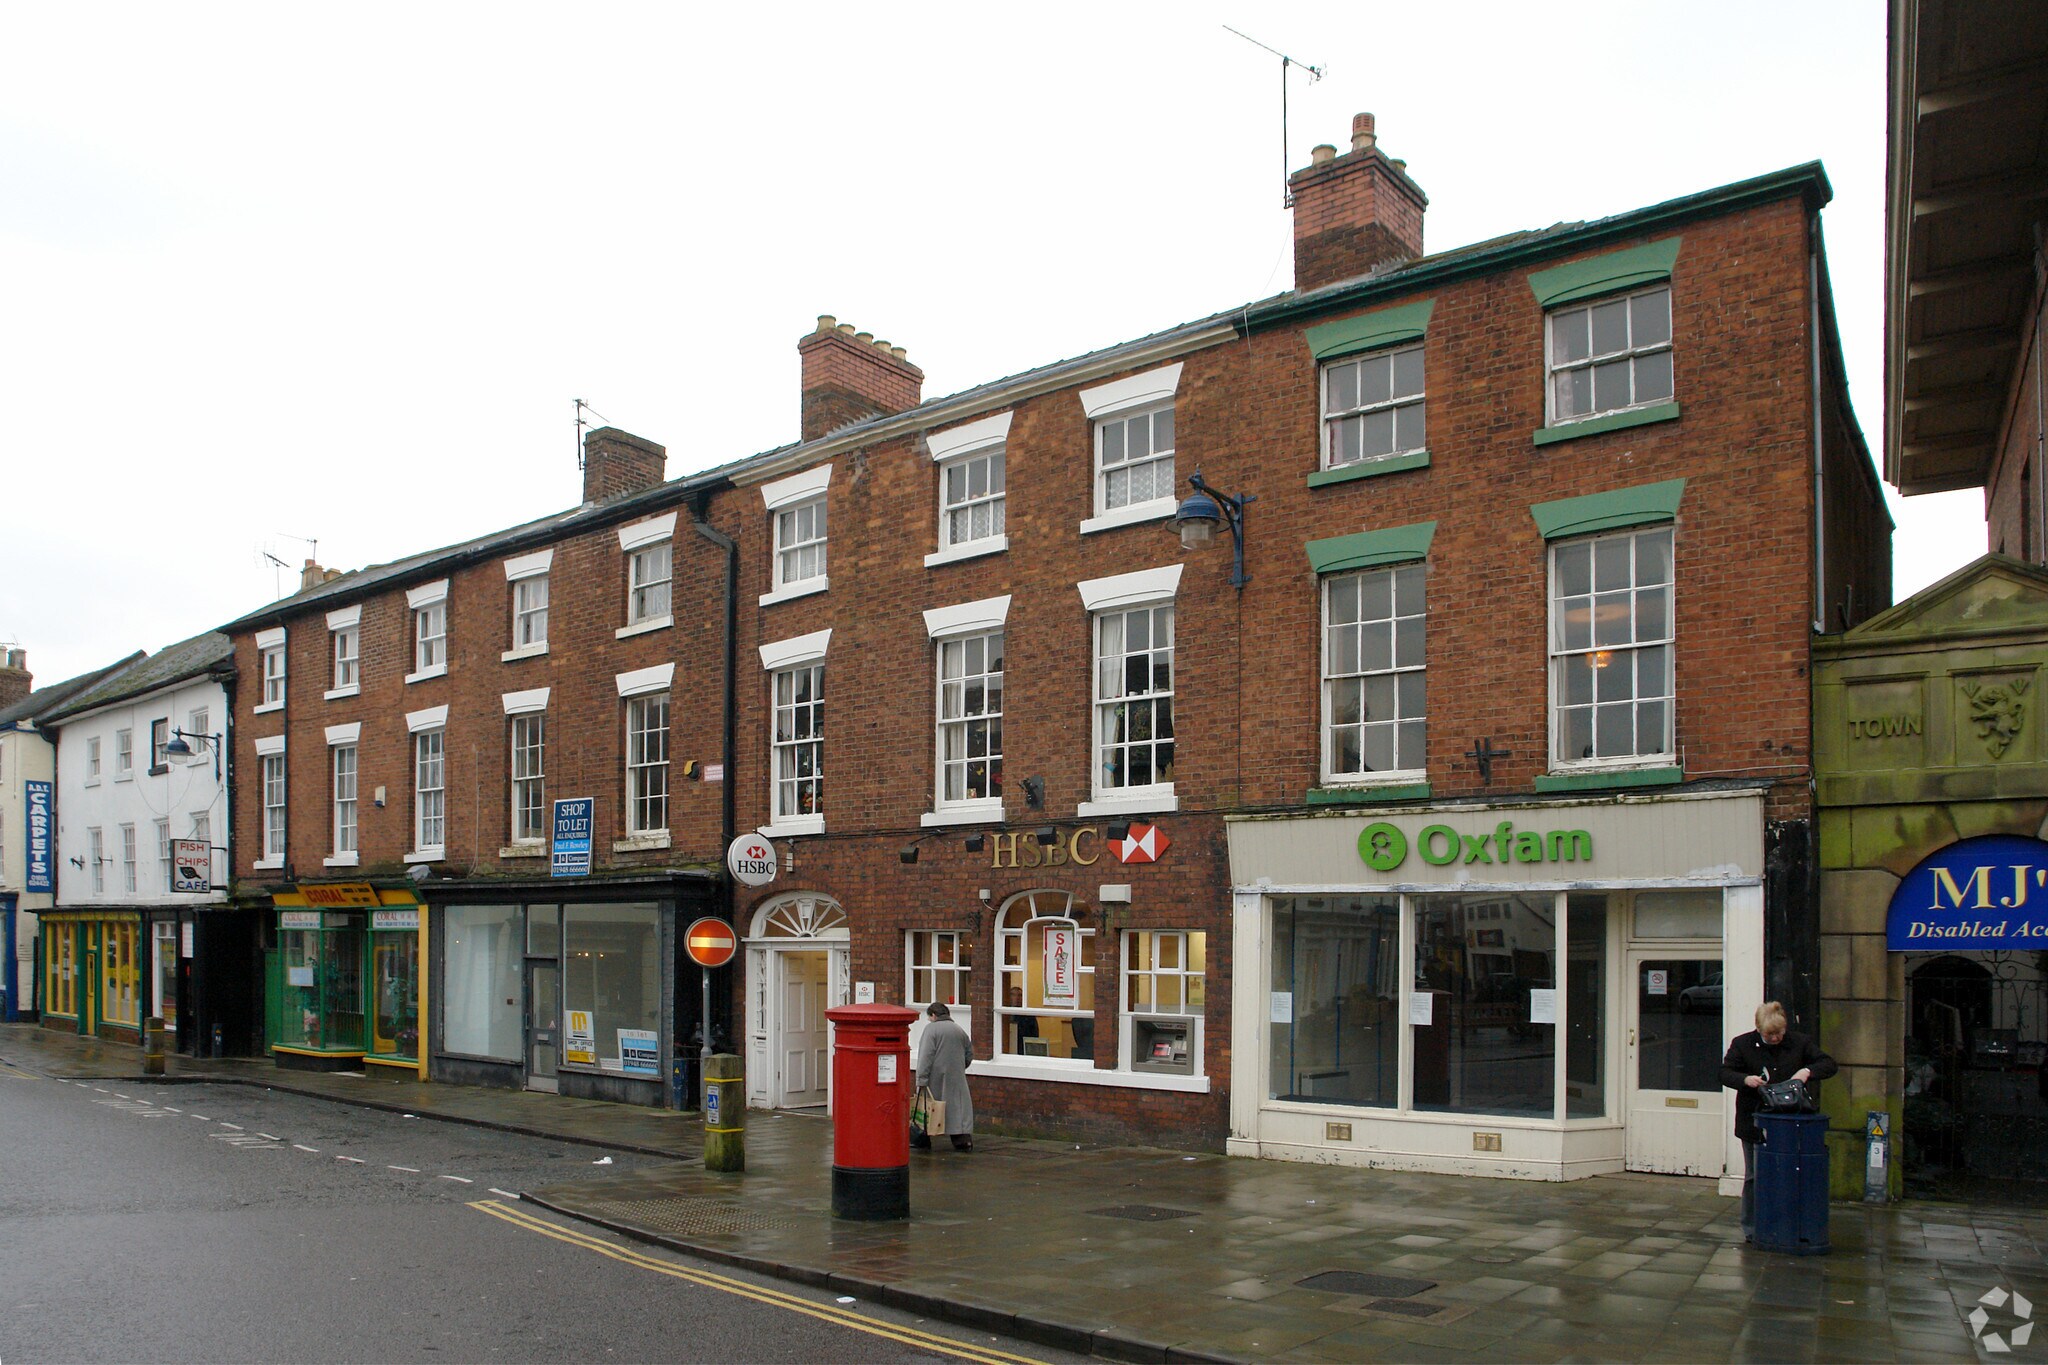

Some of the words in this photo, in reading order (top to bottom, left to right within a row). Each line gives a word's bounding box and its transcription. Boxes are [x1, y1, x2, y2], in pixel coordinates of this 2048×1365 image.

[1850, 716, 1922, 739] TOWN
[561, 803, 585, 817] SHOP
[558, 820, 570, 832] TO
[571, 819, 588, 831] LET
[30, 793, 48, 873] CARPETS
[556, 832, 564, 840] ALL
[180, 842, 204, 851] FISH
[991, 827, 1099, 868] HSBC
[1417, 821, 1592, 865] Oxfam
[176, 857, 208, 866] CHIPS
[737, 860, 774, 874] HSBC
[176, 880, 207, 890] CAFÉ
[304, 889, 346, 902] CORAL
[1907, 921, 2007, 938] Disabled
[2011, 921, 2048, 938] Ac
